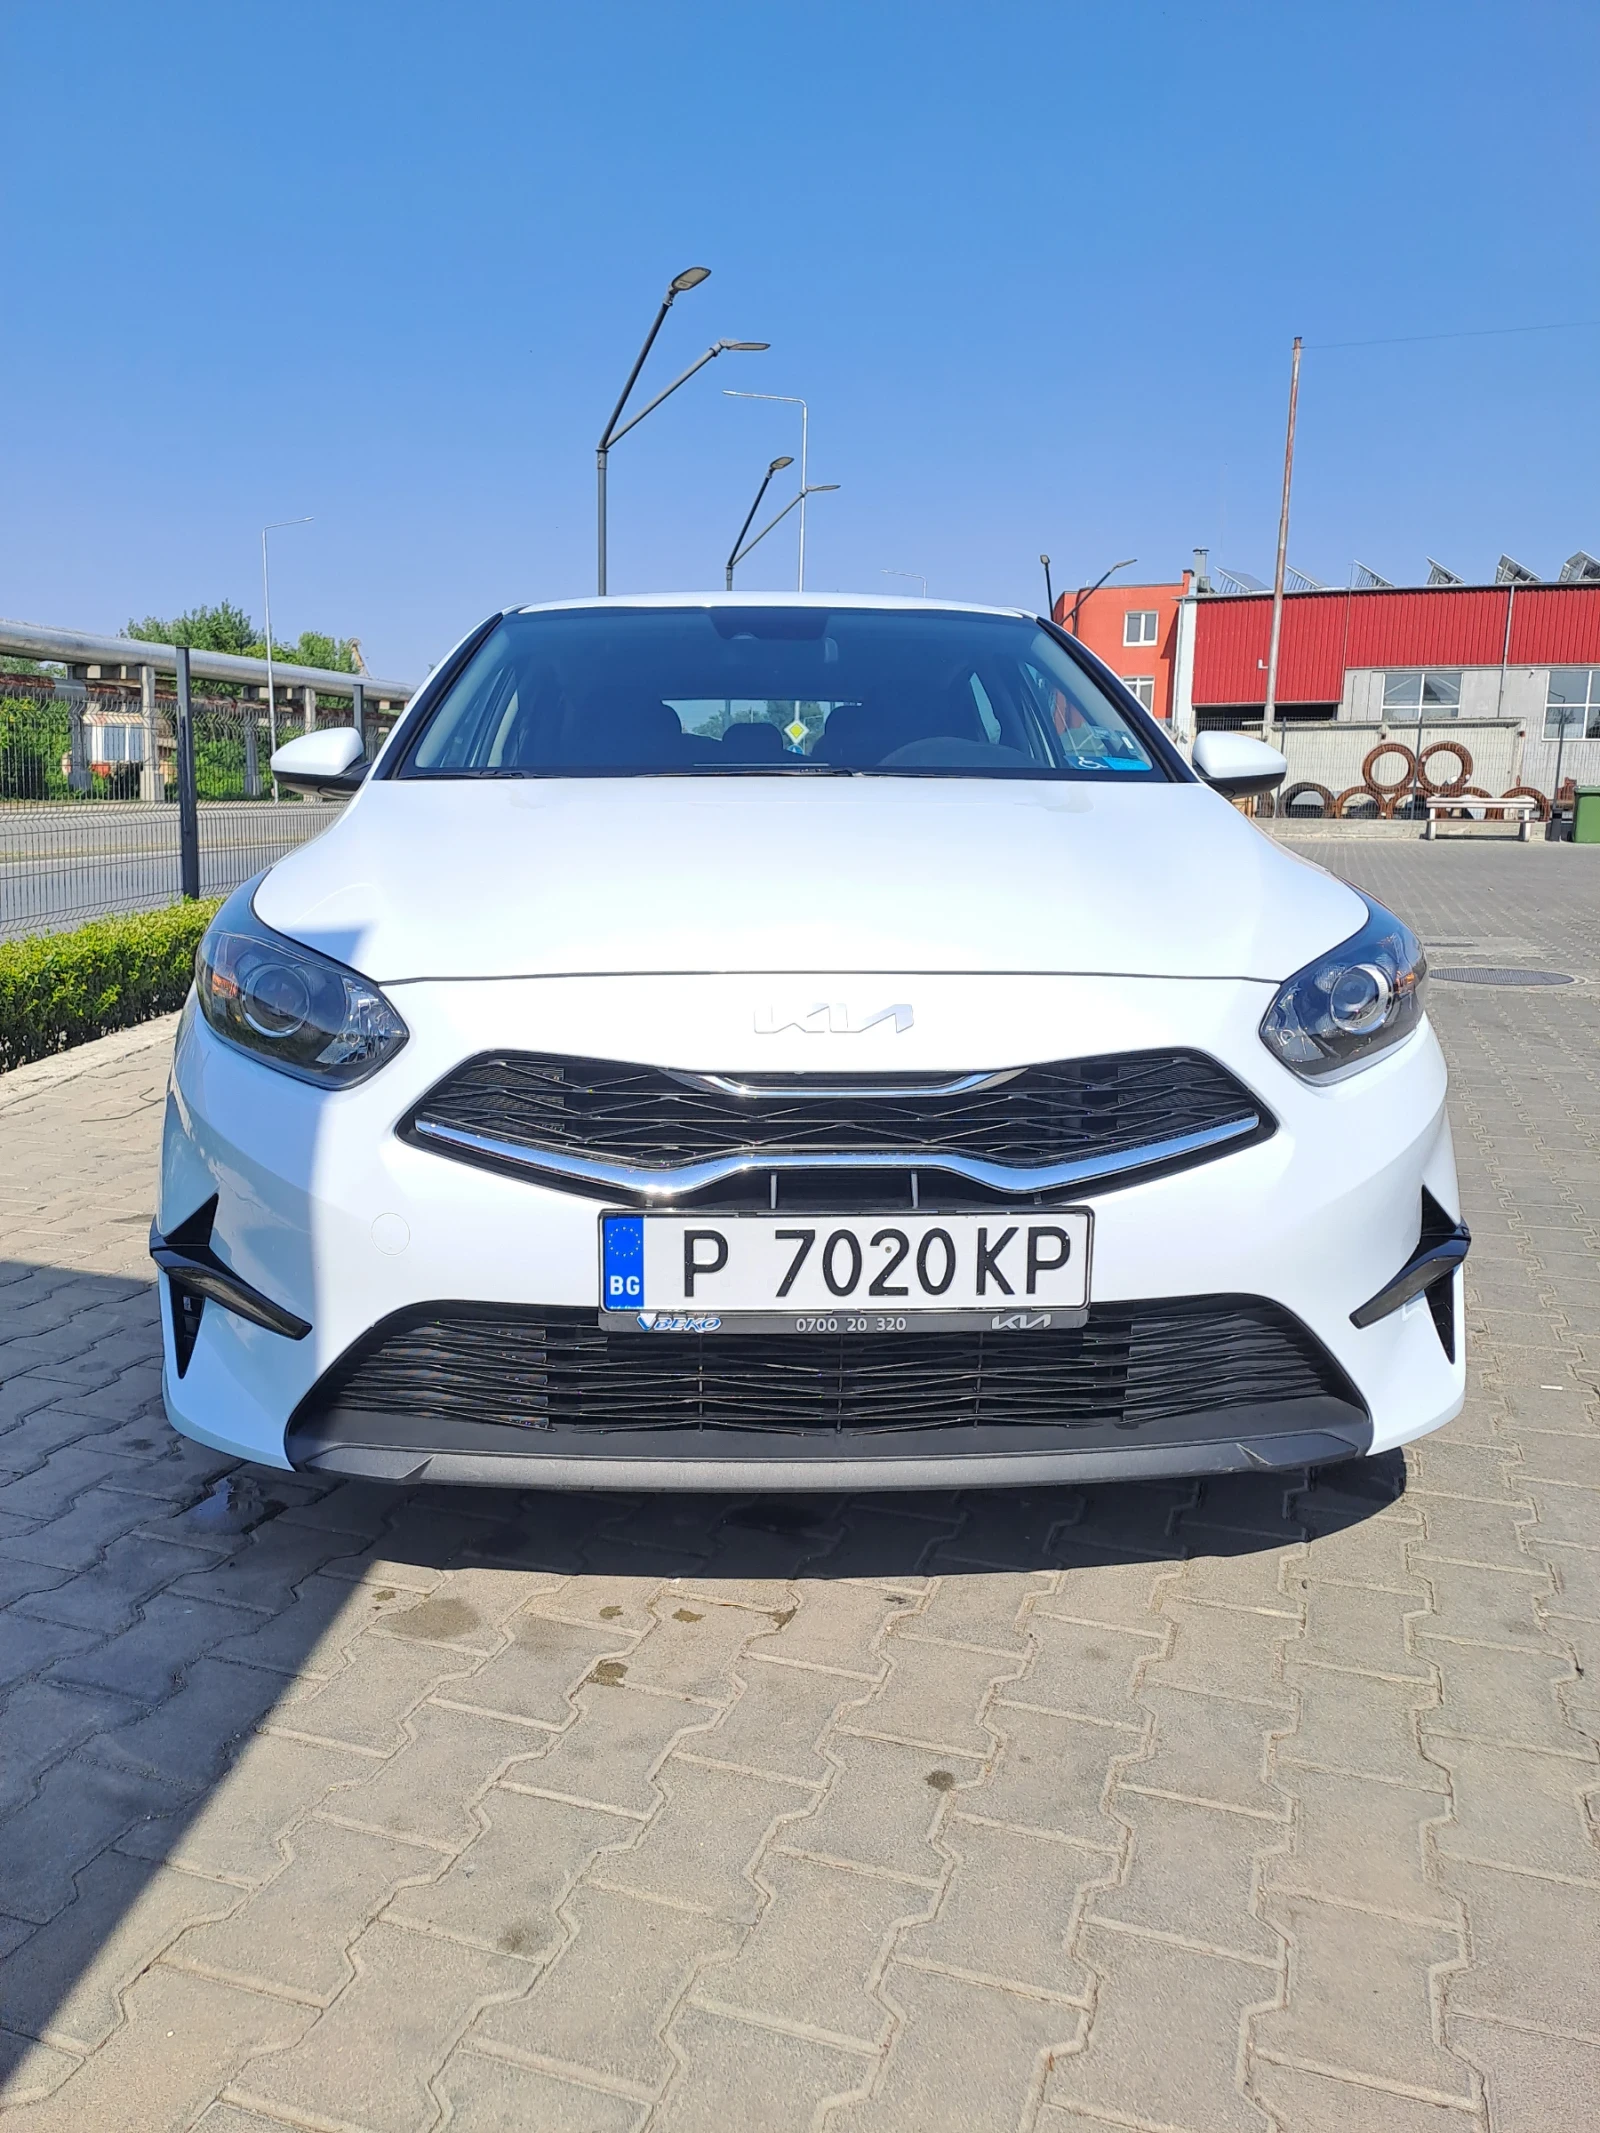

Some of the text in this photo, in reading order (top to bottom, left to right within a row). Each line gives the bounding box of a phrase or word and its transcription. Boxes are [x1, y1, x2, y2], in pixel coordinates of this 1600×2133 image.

[754, 1002, 914, 1034] KIA
[684, 1229, 729, 1298] P
[610, 1275, 640, 1296] BG
[653, 1316, 722, 1333] BEKO
[796, 1317, 907, 1332] 0700 20 320
[991, 1313, 1052, 1330] KIA
